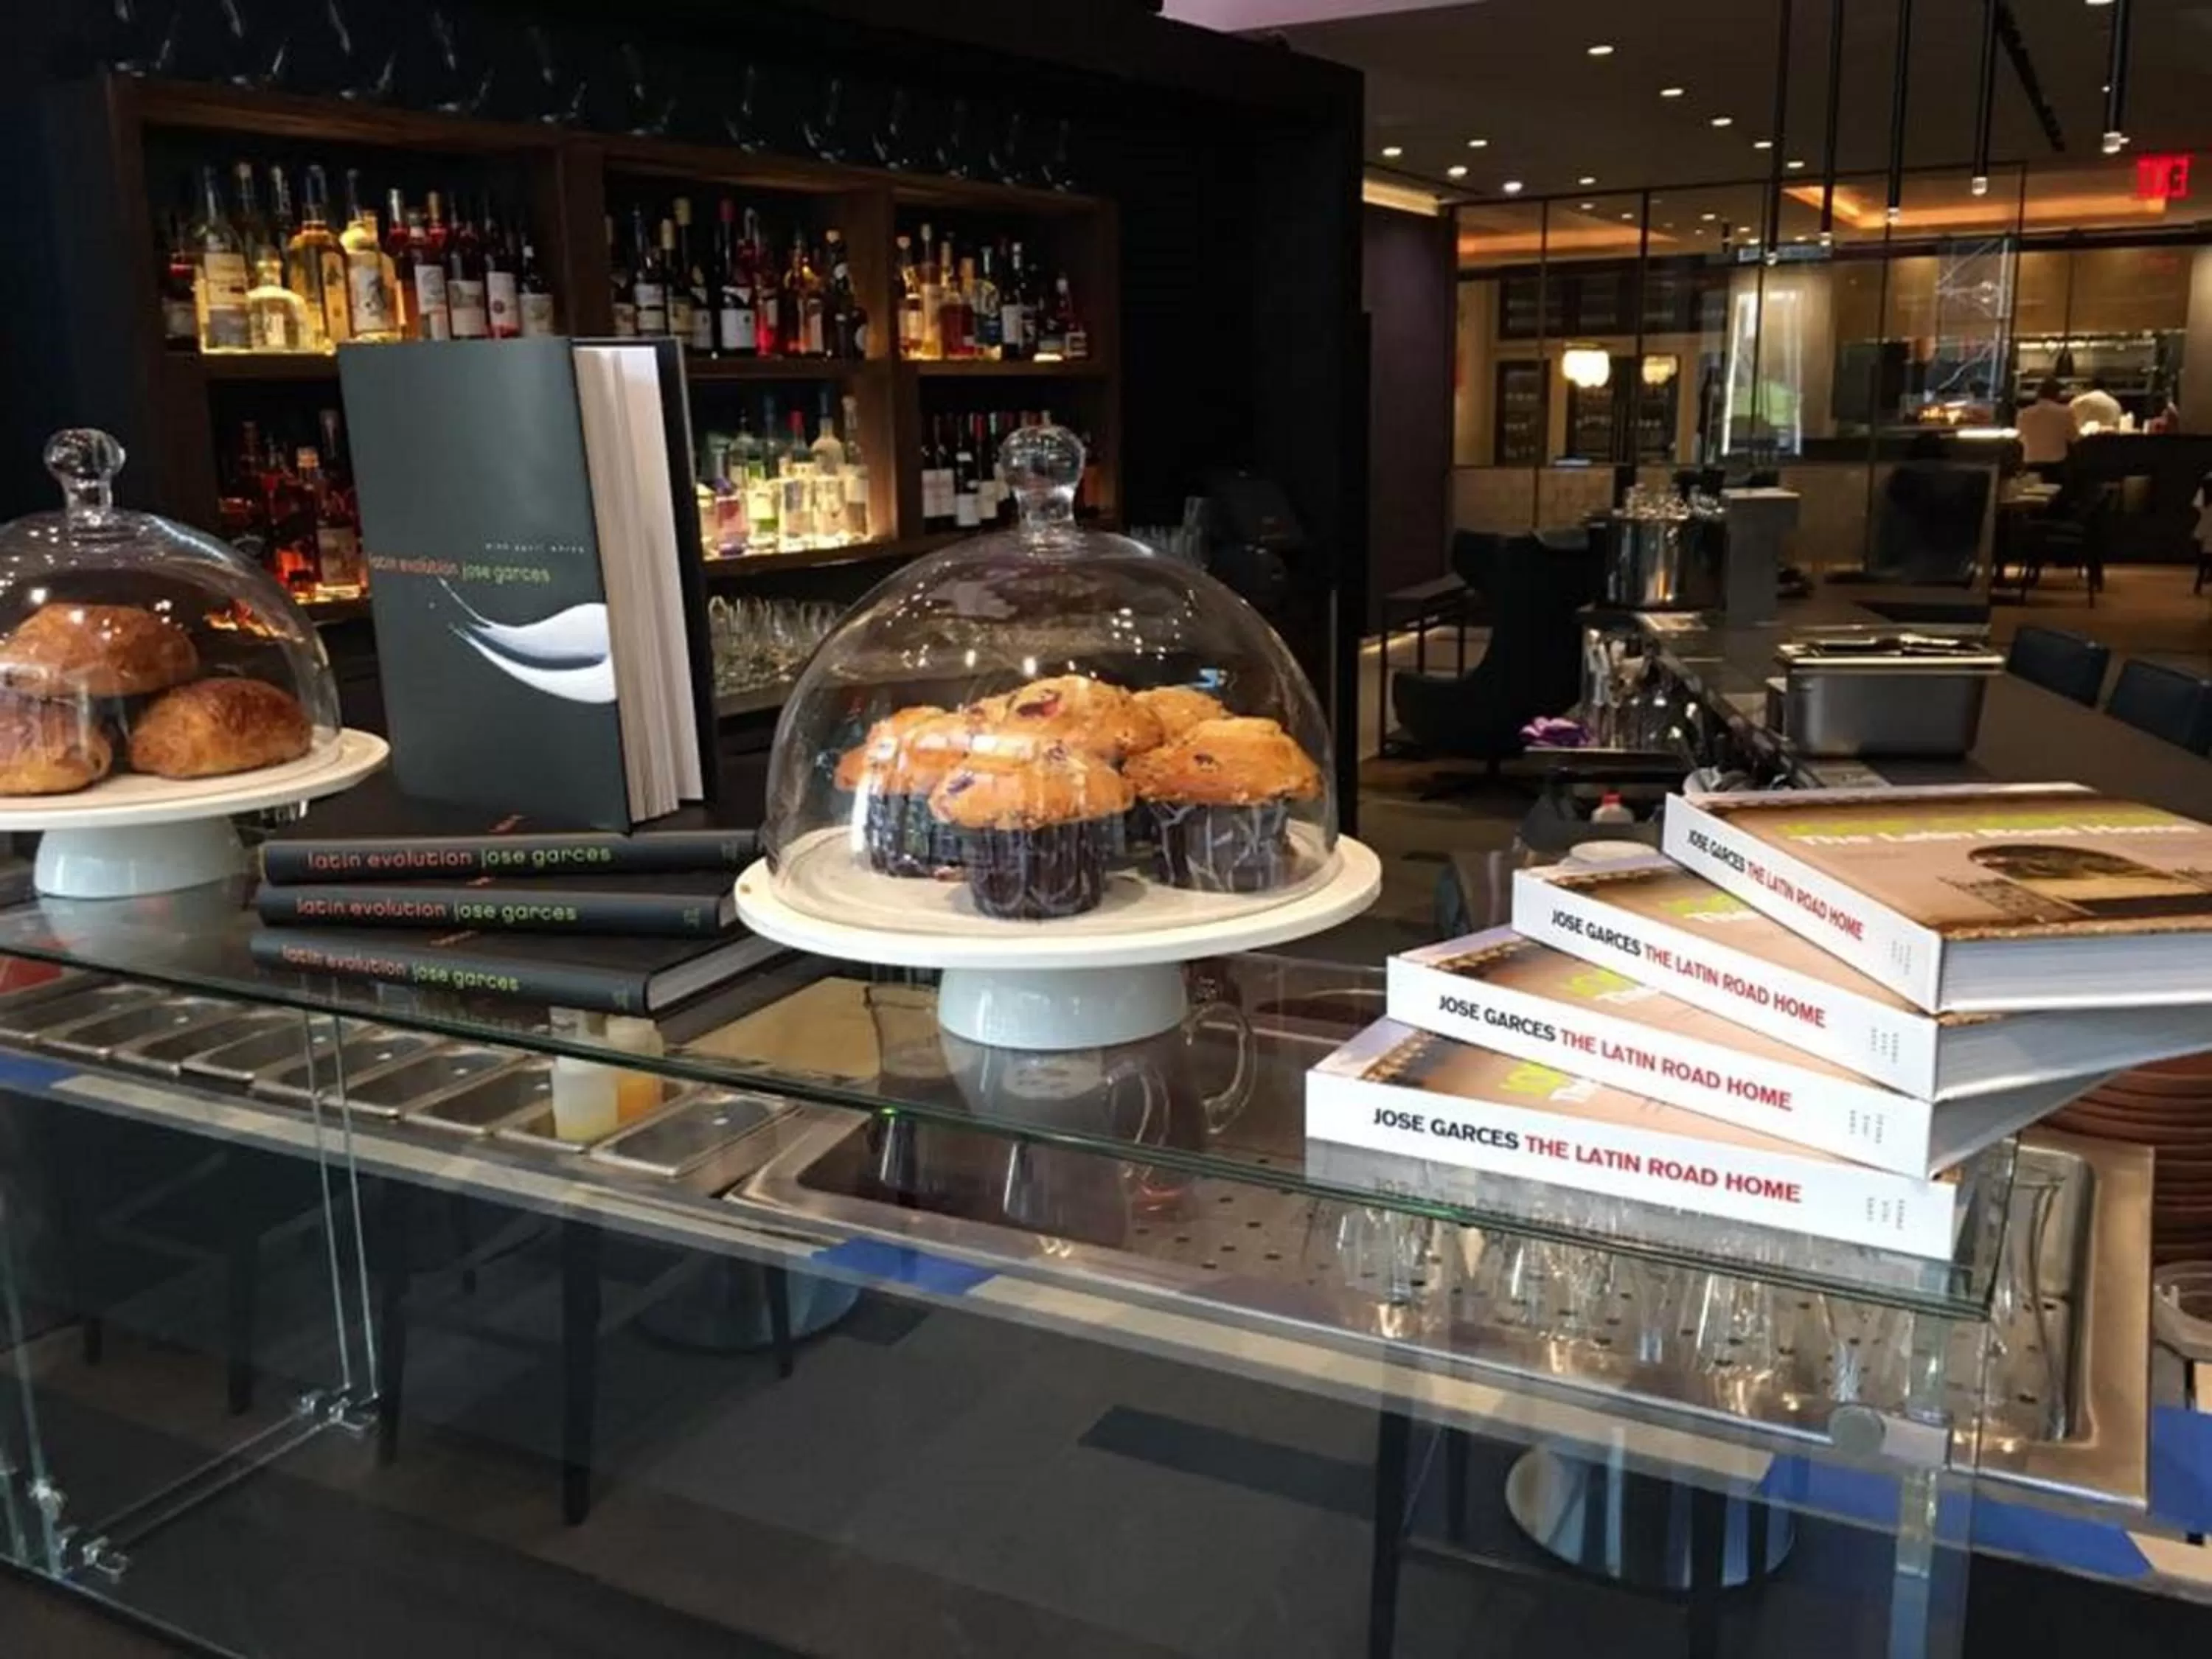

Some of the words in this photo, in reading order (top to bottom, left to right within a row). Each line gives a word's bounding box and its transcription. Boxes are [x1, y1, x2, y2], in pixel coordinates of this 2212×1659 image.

[462, 560, 490, 581] jose
[493, 565, 551, 585] garces
[307, 850, 361, 870] latin
[367, 849, 473, 869] evolution
[480, 847, 525, 869] jose
[532, 845, 611, 868] garces
[1687, 830, 1710, 854] JOSE
[1709, 841, 1746, 873] GARCES
[1747, 860, 1766, 885] THE
[1767, 872, 1794, 901] LATIN
[1796, 888, 1828, 919] ROAD
[1828, 905, 1864, 941] HOME
[296, 897, 345, 915] latin
[349, 897, 446, 917] evolution
[453, 899, 496, 922] jose
[501, 902, 577, 923] garces
[282, 945, 326, 965] latin
[327, 951, 406, 977] evolution
[411, 961, 448, 984] jose
[453, 969, 519, 991] garces
[1551, 909, 1585, 935] JOSE
[1585, 922, 1641, 956] GARCES
[1644, 944, 1674, 969] THE
[1676, 956, 1719, 986] LATIN
[1722, 973, 1770, 1006] ROAD
[1773, 992, 1826, 1029] HOME
[1439, 995, 1481, 1021] JOSE
[1484, 1007, 1557, 1042] GARCES
[1560, 1029, 1598, 1054] THE
[1601, 1040, 1656, 1072] LATIN
[1661, 1058, 1721, 1090] ROAD
[1726, 1076, 1792, 1112] HOME
[1373, 1107, 1425, 1133] JOSE
[1430, 1118, 1520, 1151] GARCES
[1524, 1134, 1570, 1161] THE
[1575, 1144, 1641, 1174] LATIN
[1647, 1157, 1719, 1188] ROAD
[1725, 1172, 1803, 1204] HOME
